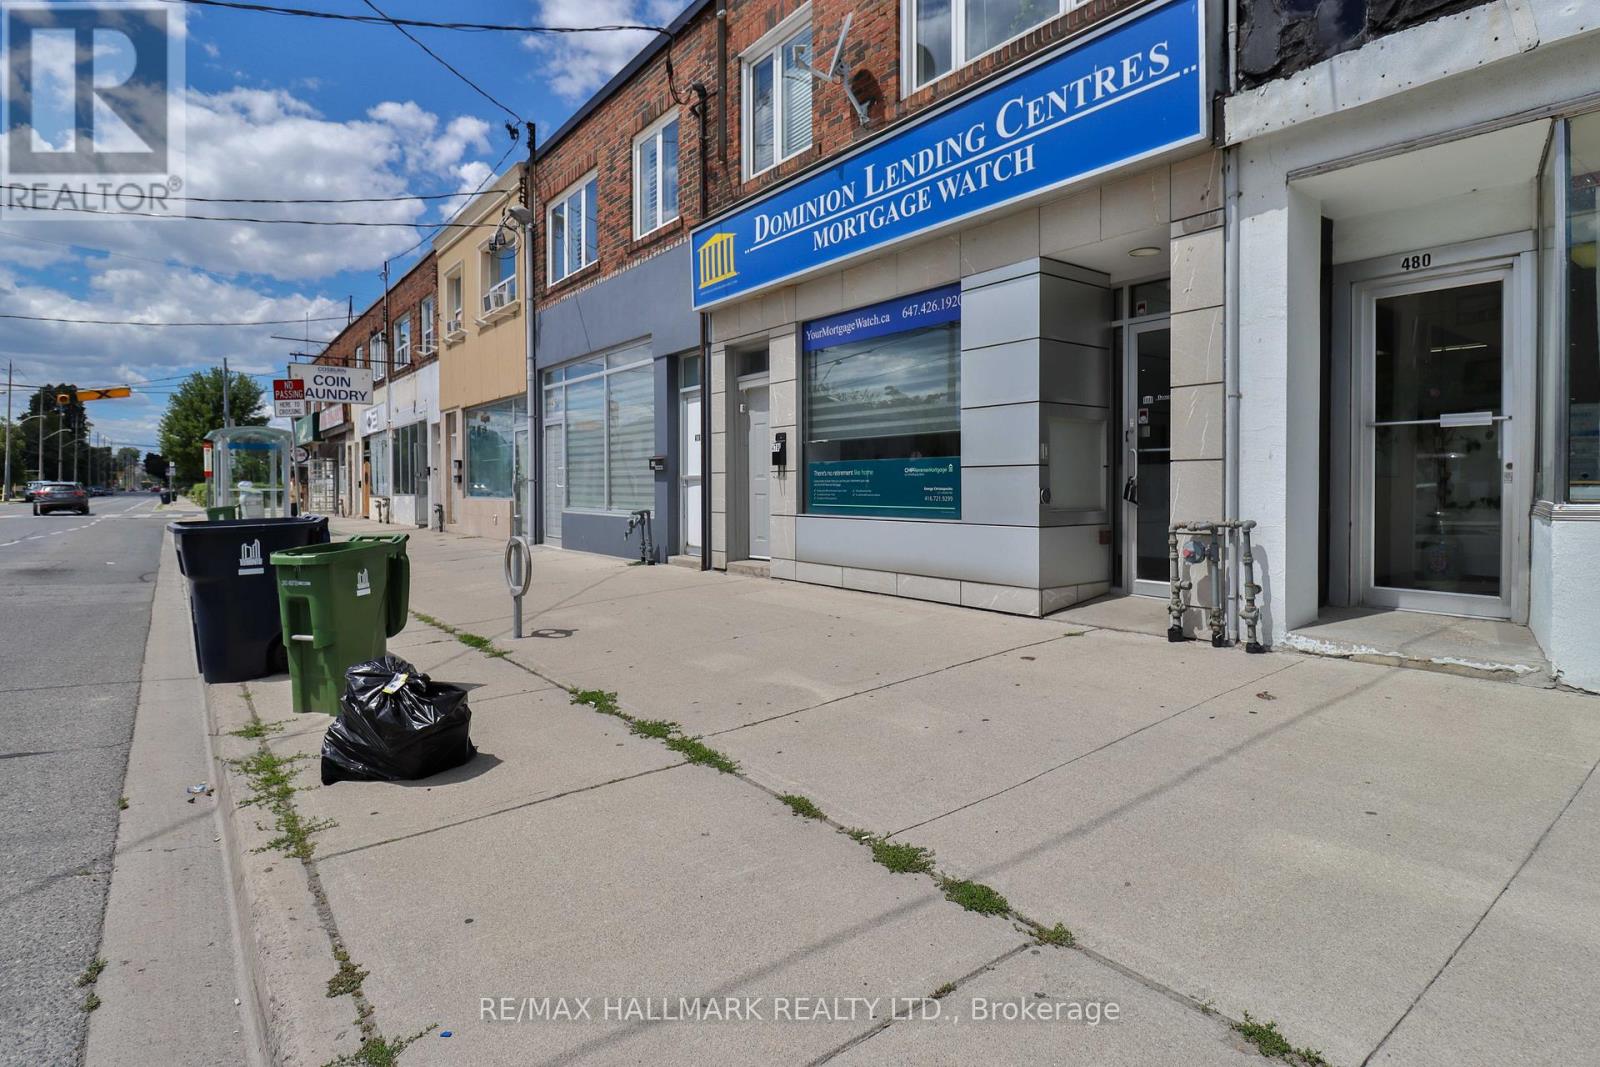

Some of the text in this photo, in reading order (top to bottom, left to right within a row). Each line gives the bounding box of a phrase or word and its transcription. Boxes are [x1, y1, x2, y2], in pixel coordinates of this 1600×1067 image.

[754, 40, 1170, 244] DOMINION LENDING CENTRES
[812, 143, 1036, 251] MORTGAGE WATCH
[1401, 253, 1431, 271] 480
[806, 313, 891, 341] YourMortgageWatch.ca
[284, 380, 294, 390] NO
[313, 374, 351, 388] COIN
[275, 389, 304, 400] PASSING
[305, 387, 368, 402] AUNDRY
